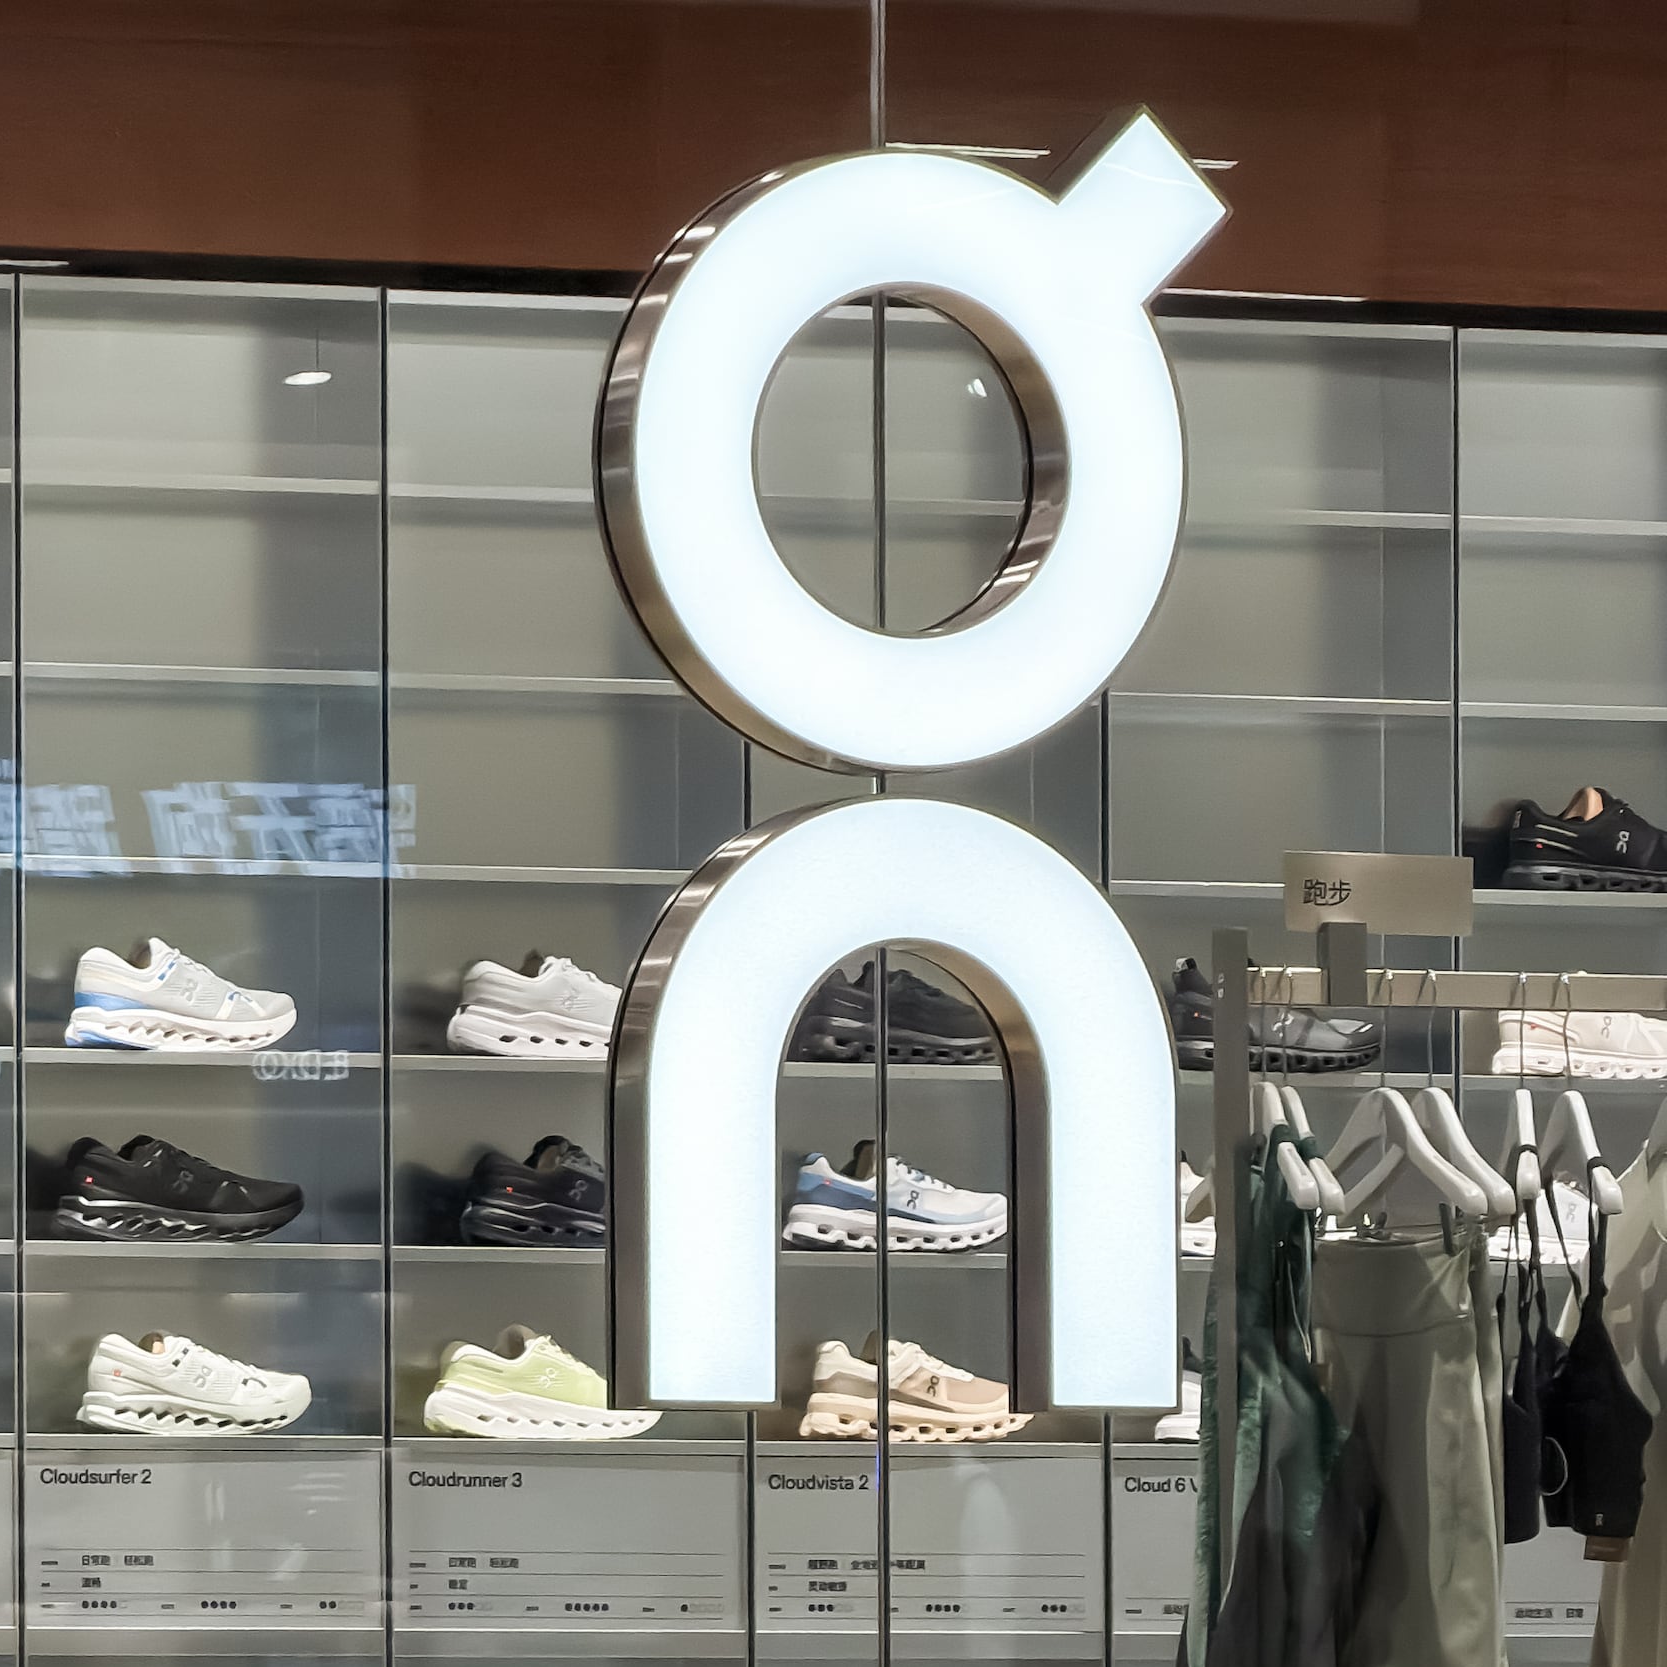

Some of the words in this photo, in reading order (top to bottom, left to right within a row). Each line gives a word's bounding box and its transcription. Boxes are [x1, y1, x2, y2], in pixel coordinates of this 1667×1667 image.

[1303, 879, 1351, 906] 跑步
[40, 1468, 138, 1484] Cloudsurfer
[141, 1468, 152, 1484] 2
[409, 1471, 508, 1487] Cloudrunner
[512, 1472, 523, 1488] 3
[768, 1474, 854, 1490] Cloudvista
[858, 1474, 869, 1490] 2
[1125, 1477, 1171, 1492] Cloud
[1175, 1477, 1185, 1492] 6
